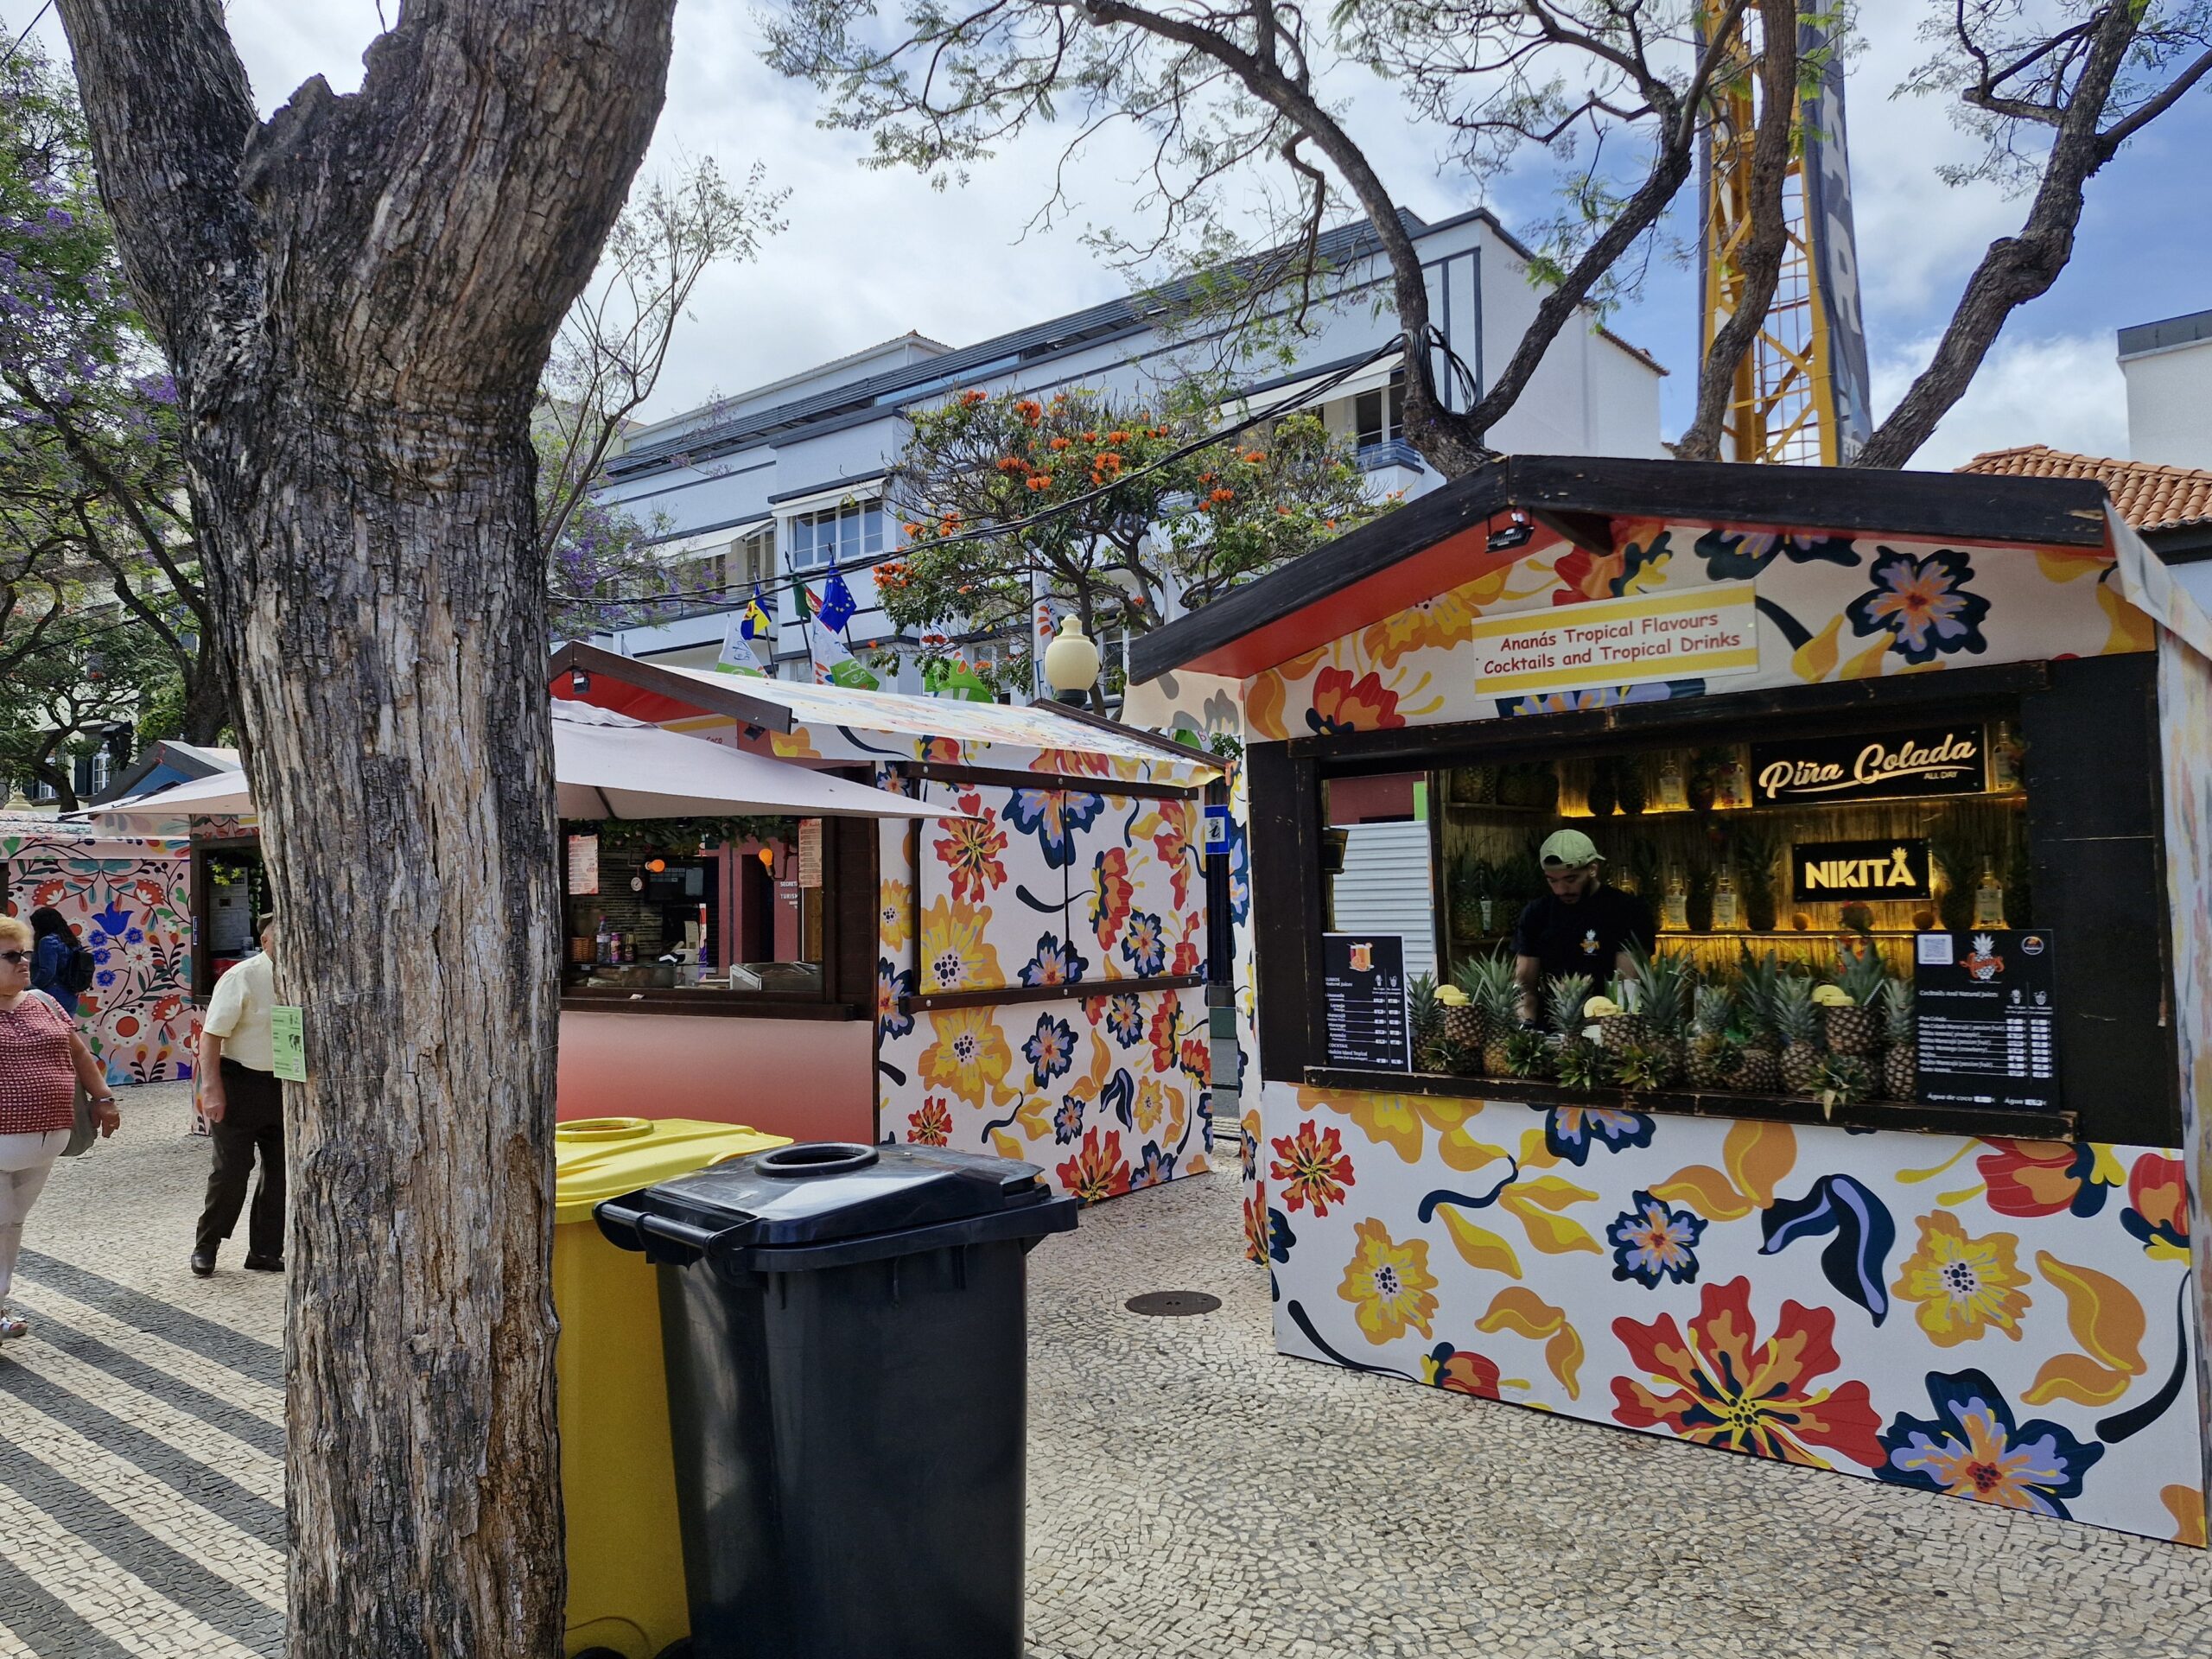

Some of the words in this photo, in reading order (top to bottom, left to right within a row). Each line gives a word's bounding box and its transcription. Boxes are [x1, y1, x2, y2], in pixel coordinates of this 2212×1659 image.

[1500, 631, 1557, 652] Ananás
[1565, 621, 1633, 645] Tropical
[1642, 613, 1719, 634] Flavours
[1484, 650, 1554, 675] Cocktails
[1563, 648, 1592, 665] and
[1600, 638, 1671, 662] Tropical
[1681, 632, 1741, 653] Drinks
[1758, 760, 1845, 799] Piña
[1853, 733, 1977, 785] Colada
[1939, 770, 1959, 779] DAY
[1805, 853, 1916, 889] NIKITA
